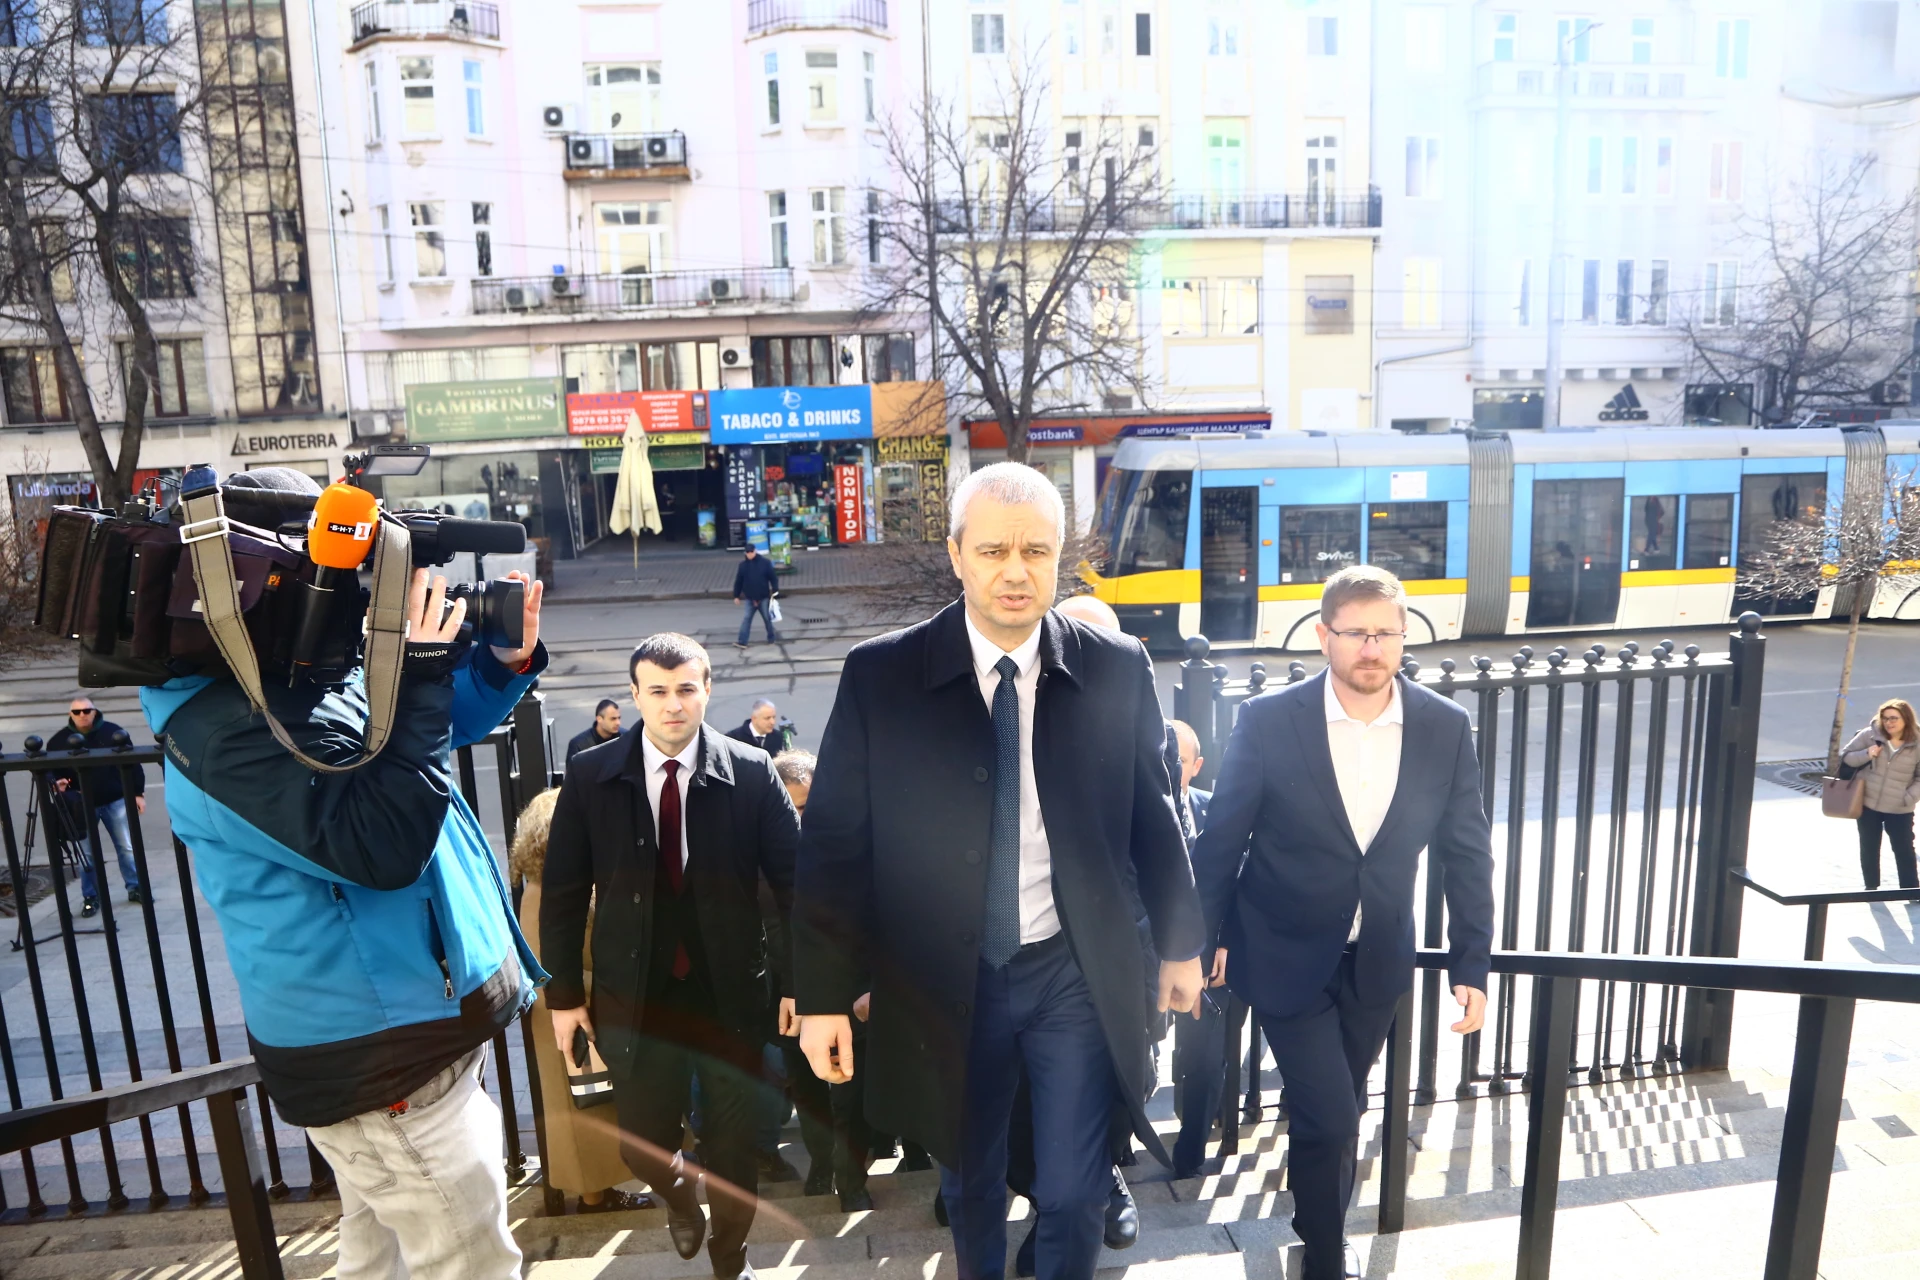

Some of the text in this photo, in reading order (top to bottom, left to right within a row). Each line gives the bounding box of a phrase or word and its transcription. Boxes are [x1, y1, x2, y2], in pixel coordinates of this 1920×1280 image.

[416, 393, 556, 416] GAMBRINUS
[721, 409, 861, 430] TABACO & DRINKS
[1027, 429, 1076, 440] ostbank
[1137, 427, 1164, 436] ЦЕНТЪР
[1210, 424, 1237, 432] МАЛЪК
[250, 432, 338, 451] EUROTERRA
[585, 435, 665, 447] НОТАУС
[878, 434, 945, 454] CHANGE
[738, 460, 747, 511] АЛКОХОЛ
[747, 471, 756, 518] ЦИГАРИ
[843, 466, 858, 540] NON STOP
[1316, 550, 1355, 561] SWING
